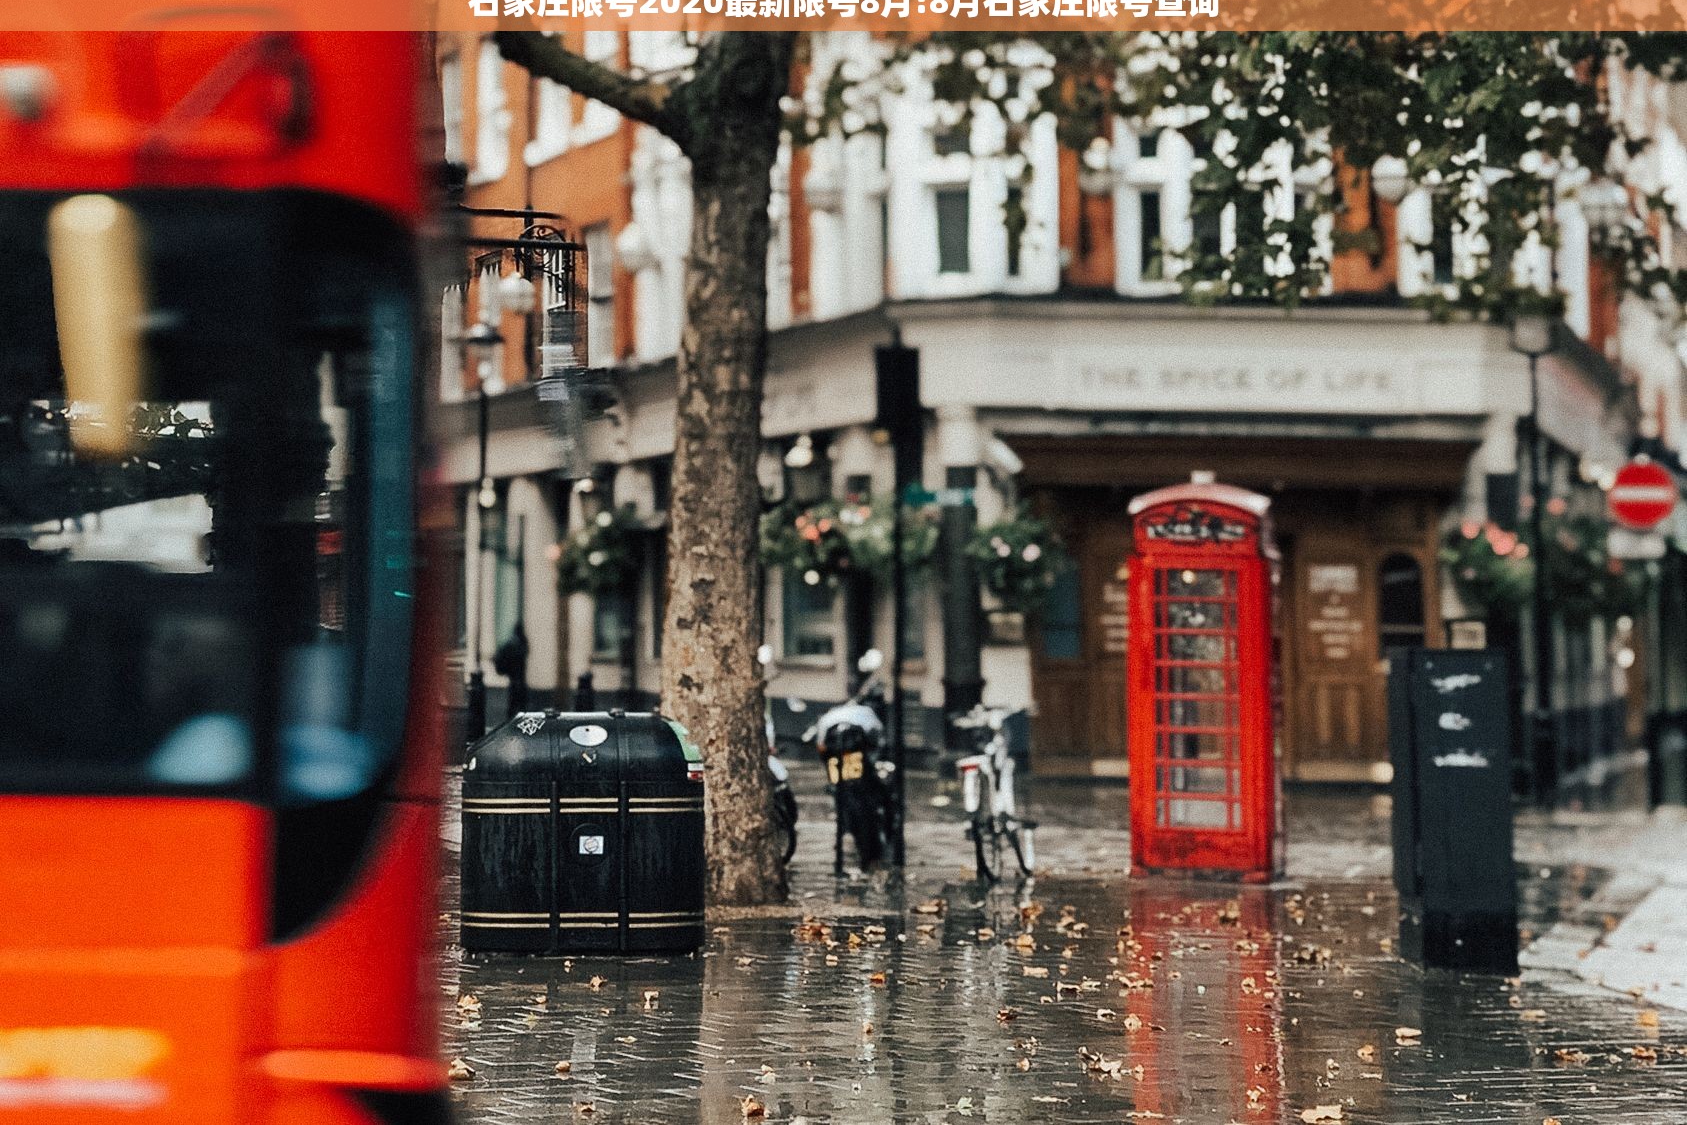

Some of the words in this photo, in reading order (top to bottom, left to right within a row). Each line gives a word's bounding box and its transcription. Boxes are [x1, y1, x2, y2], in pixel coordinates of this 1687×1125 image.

[1081, 365, 1140, 389] THE
[1159, 365, 1253, 391] SPICE
[1265, 366, 1309, 392] OF
[1323, 366, 1393, 392] LIFE
